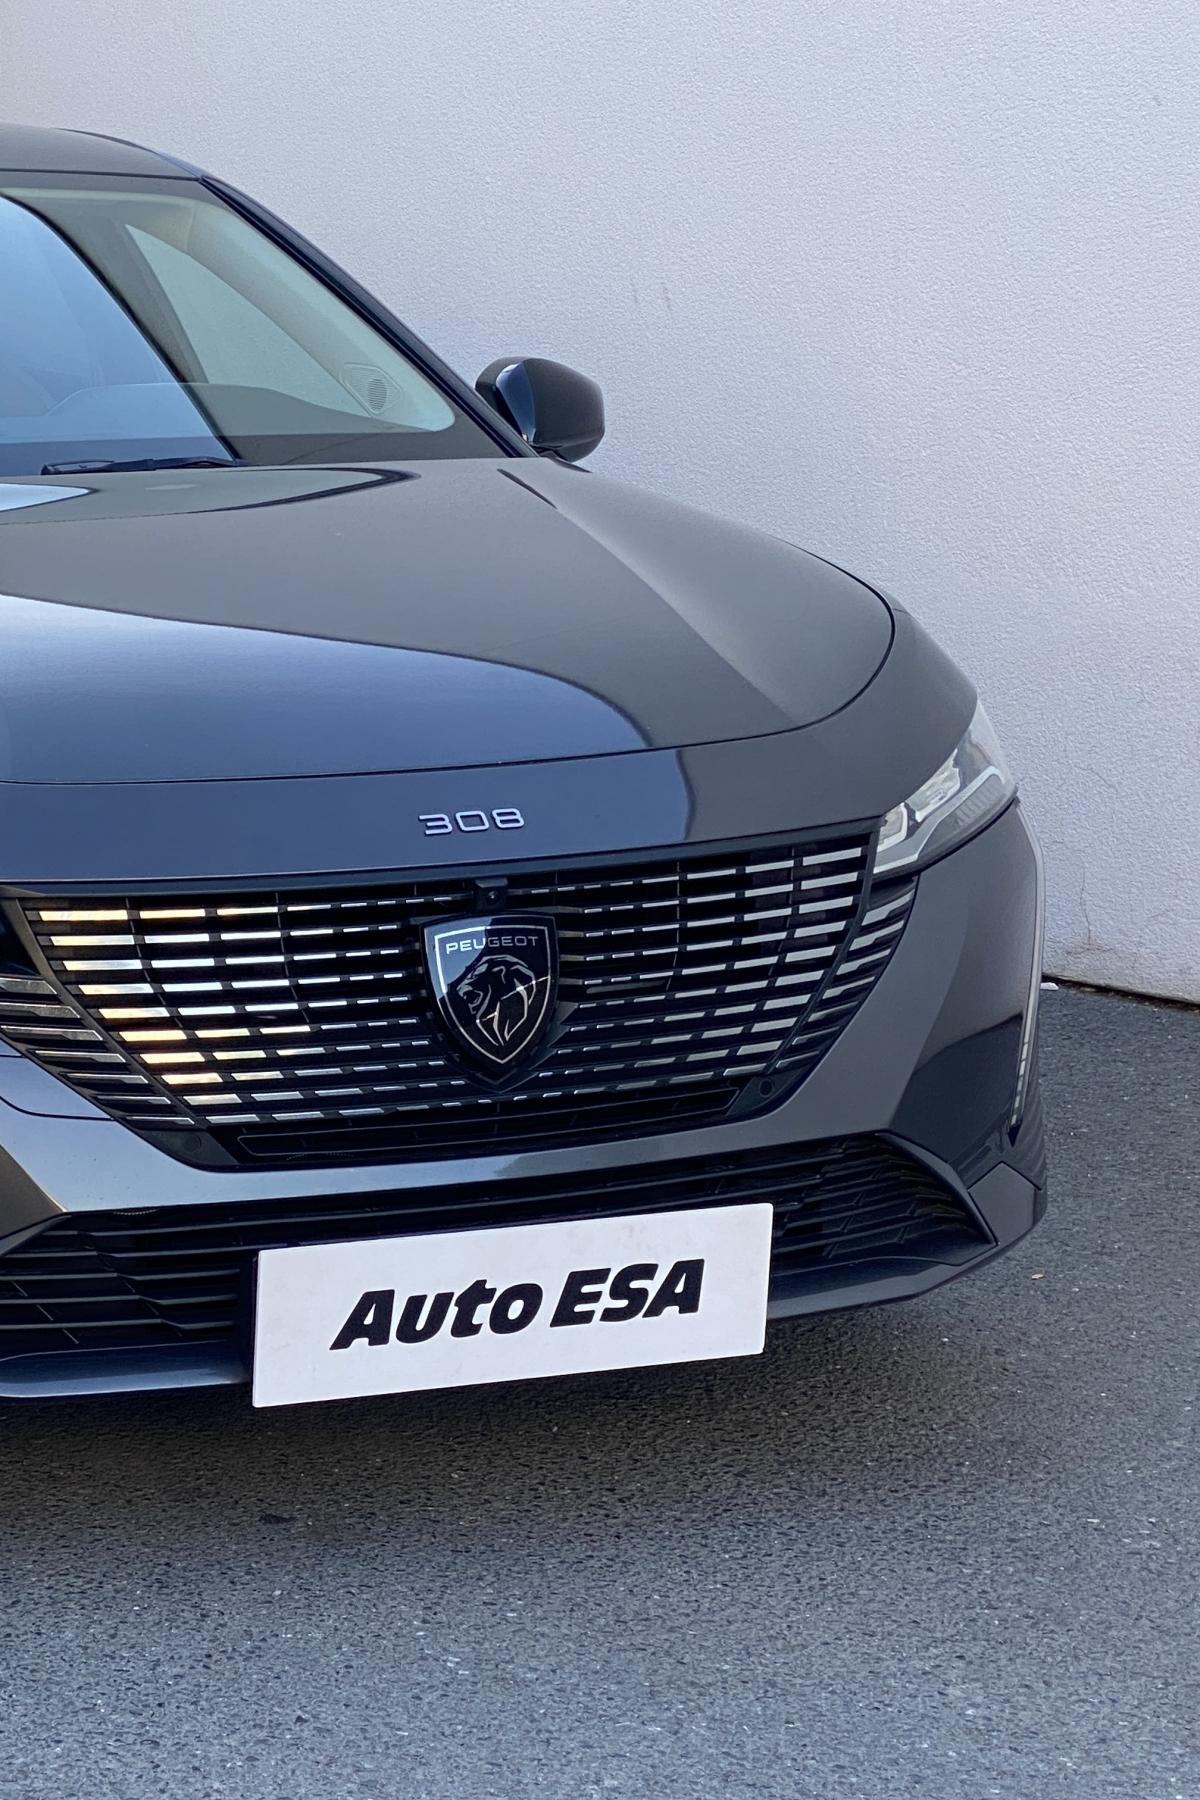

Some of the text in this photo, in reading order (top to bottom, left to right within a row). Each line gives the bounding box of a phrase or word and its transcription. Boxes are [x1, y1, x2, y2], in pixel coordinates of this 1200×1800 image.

[419, 808, 525, 835] 308
[446, 936, 539, 954] PEUGEOT
[329, 1258, 705, 1351] Auto ESA
